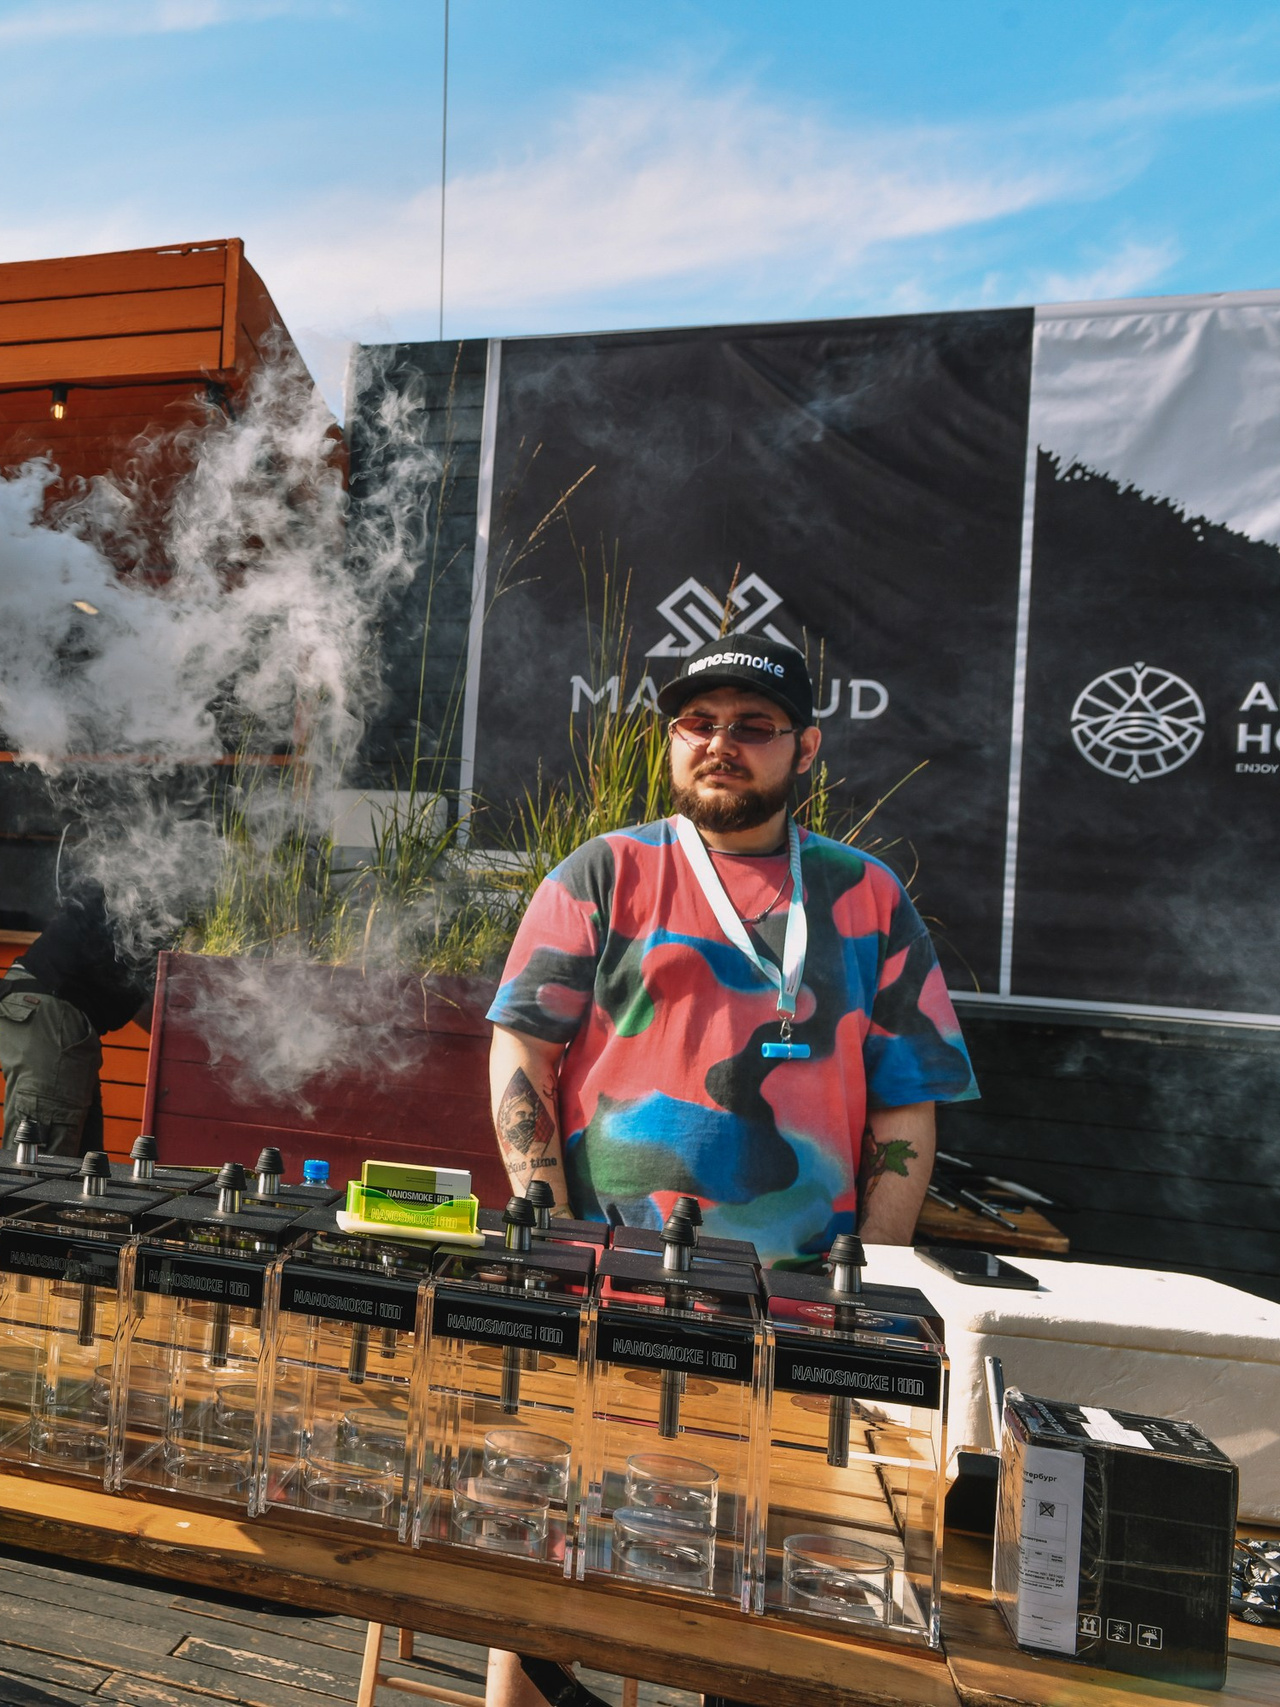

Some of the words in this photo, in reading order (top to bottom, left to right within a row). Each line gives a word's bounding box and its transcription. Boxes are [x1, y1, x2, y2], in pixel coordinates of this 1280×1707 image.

[688, 651, 785, 678] nanosmoke
[570, 675, 889, 719] MAUD
[1237, 723, 1280, 754] H
[1235, 763, 1279, 773] ENJOY
[530, 1157, 557, 1168] time
[386, 1189, 433, 1203] NANOSMOKE
[370, 1207, 435, 1227] NANOSMOKE
[148, 1270, 223, 1293] NANOSMOKE
[294, 1289, 373, 1315] NANOSMOKE
[447, 1314, 533, 1340] NANOSMOKE
[613, 1338, 704, 1365] NANOSMOKE
[792, 1364, 889, 1391] NANOSMOKE
